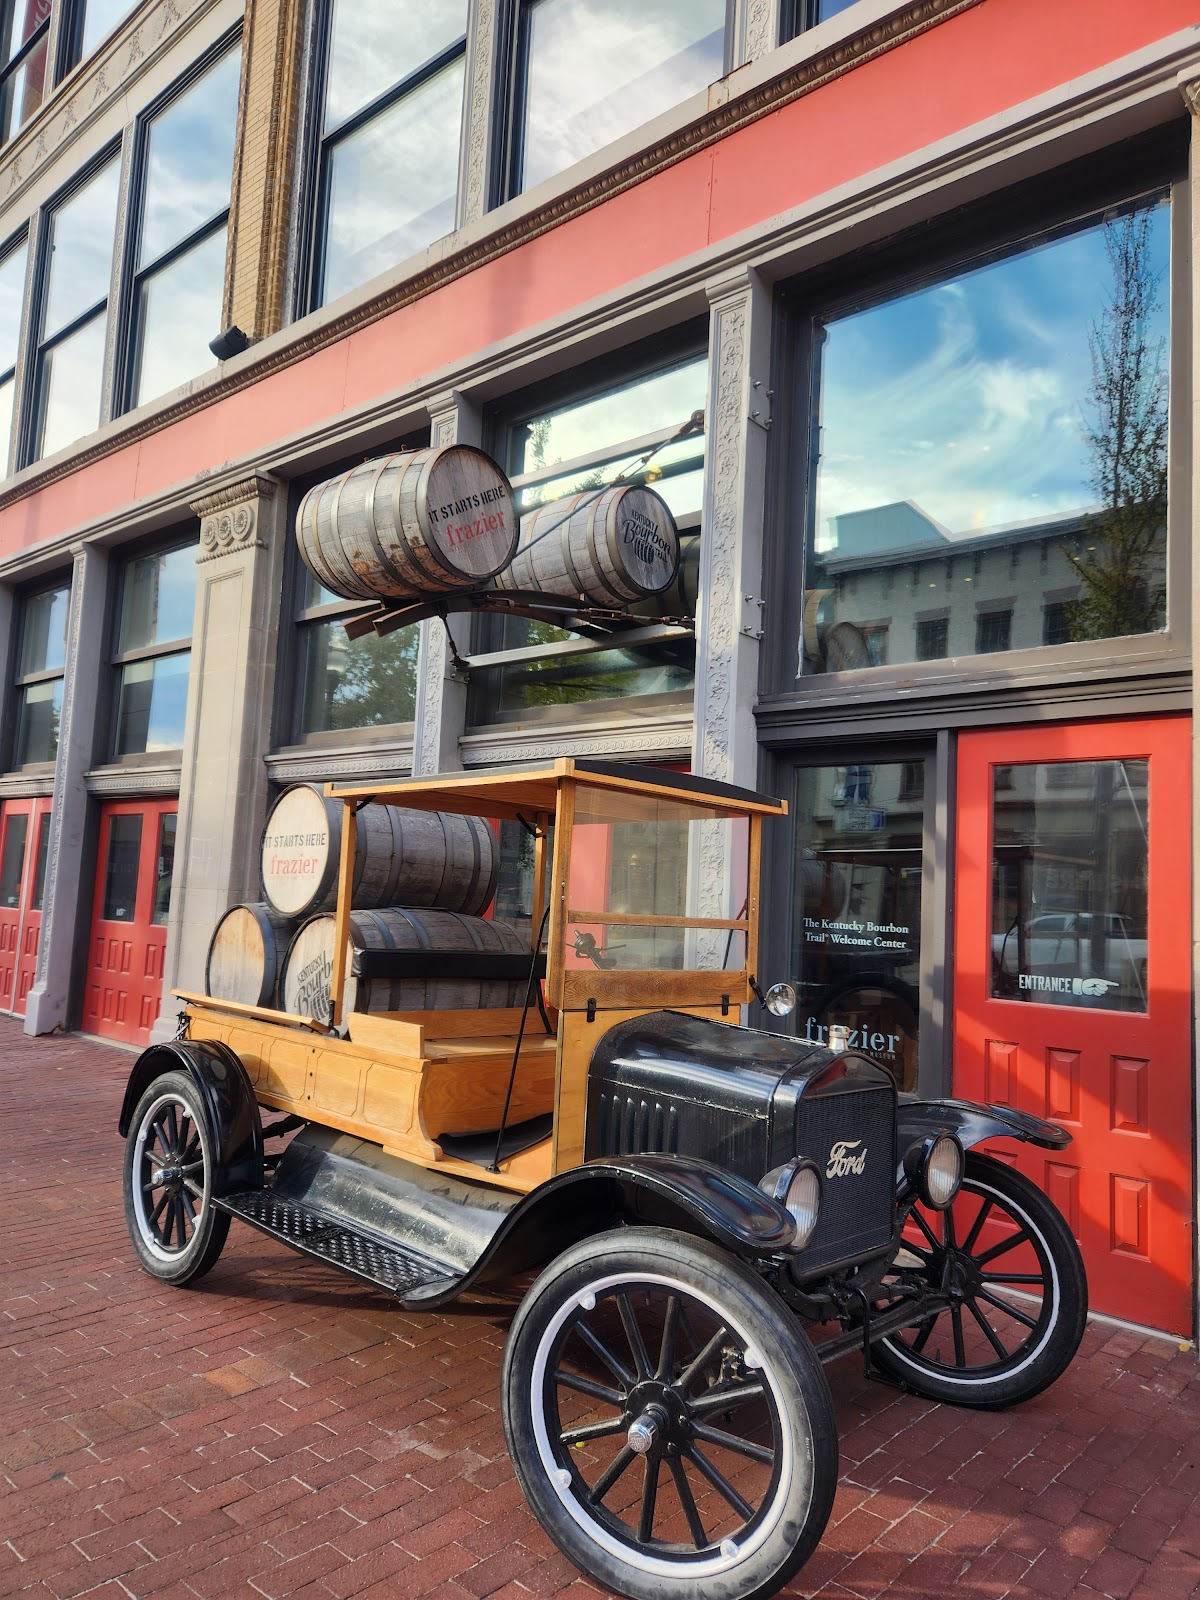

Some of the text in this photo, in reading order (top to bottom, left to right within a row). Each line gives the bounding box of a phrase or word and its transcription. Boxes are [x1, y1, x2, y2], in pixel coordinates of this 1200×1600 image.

[428, 485, 506, 524] IT STARTS HERE
[446, 511, 506, 547] frazier
[622, 519, 671, 556] Bourbon
[264, 832, 327, 849] IT STARTS HERE
[270, 853, 318, 875] frazier
[803, 917, 909, 934] The Kentucky Bourbon
[830, 933, 872, 946] Welcome
[873, 936, 907, 949] Center
[293, 949, 335, 1018] Bourb
[296, 952, 324, 985] KENTUCKY
[1018, 974, 1072, 993] ENTRANCE
[804, 1016, 900, 1053] frzier
[825, 1139, 868, 1179] Ford
